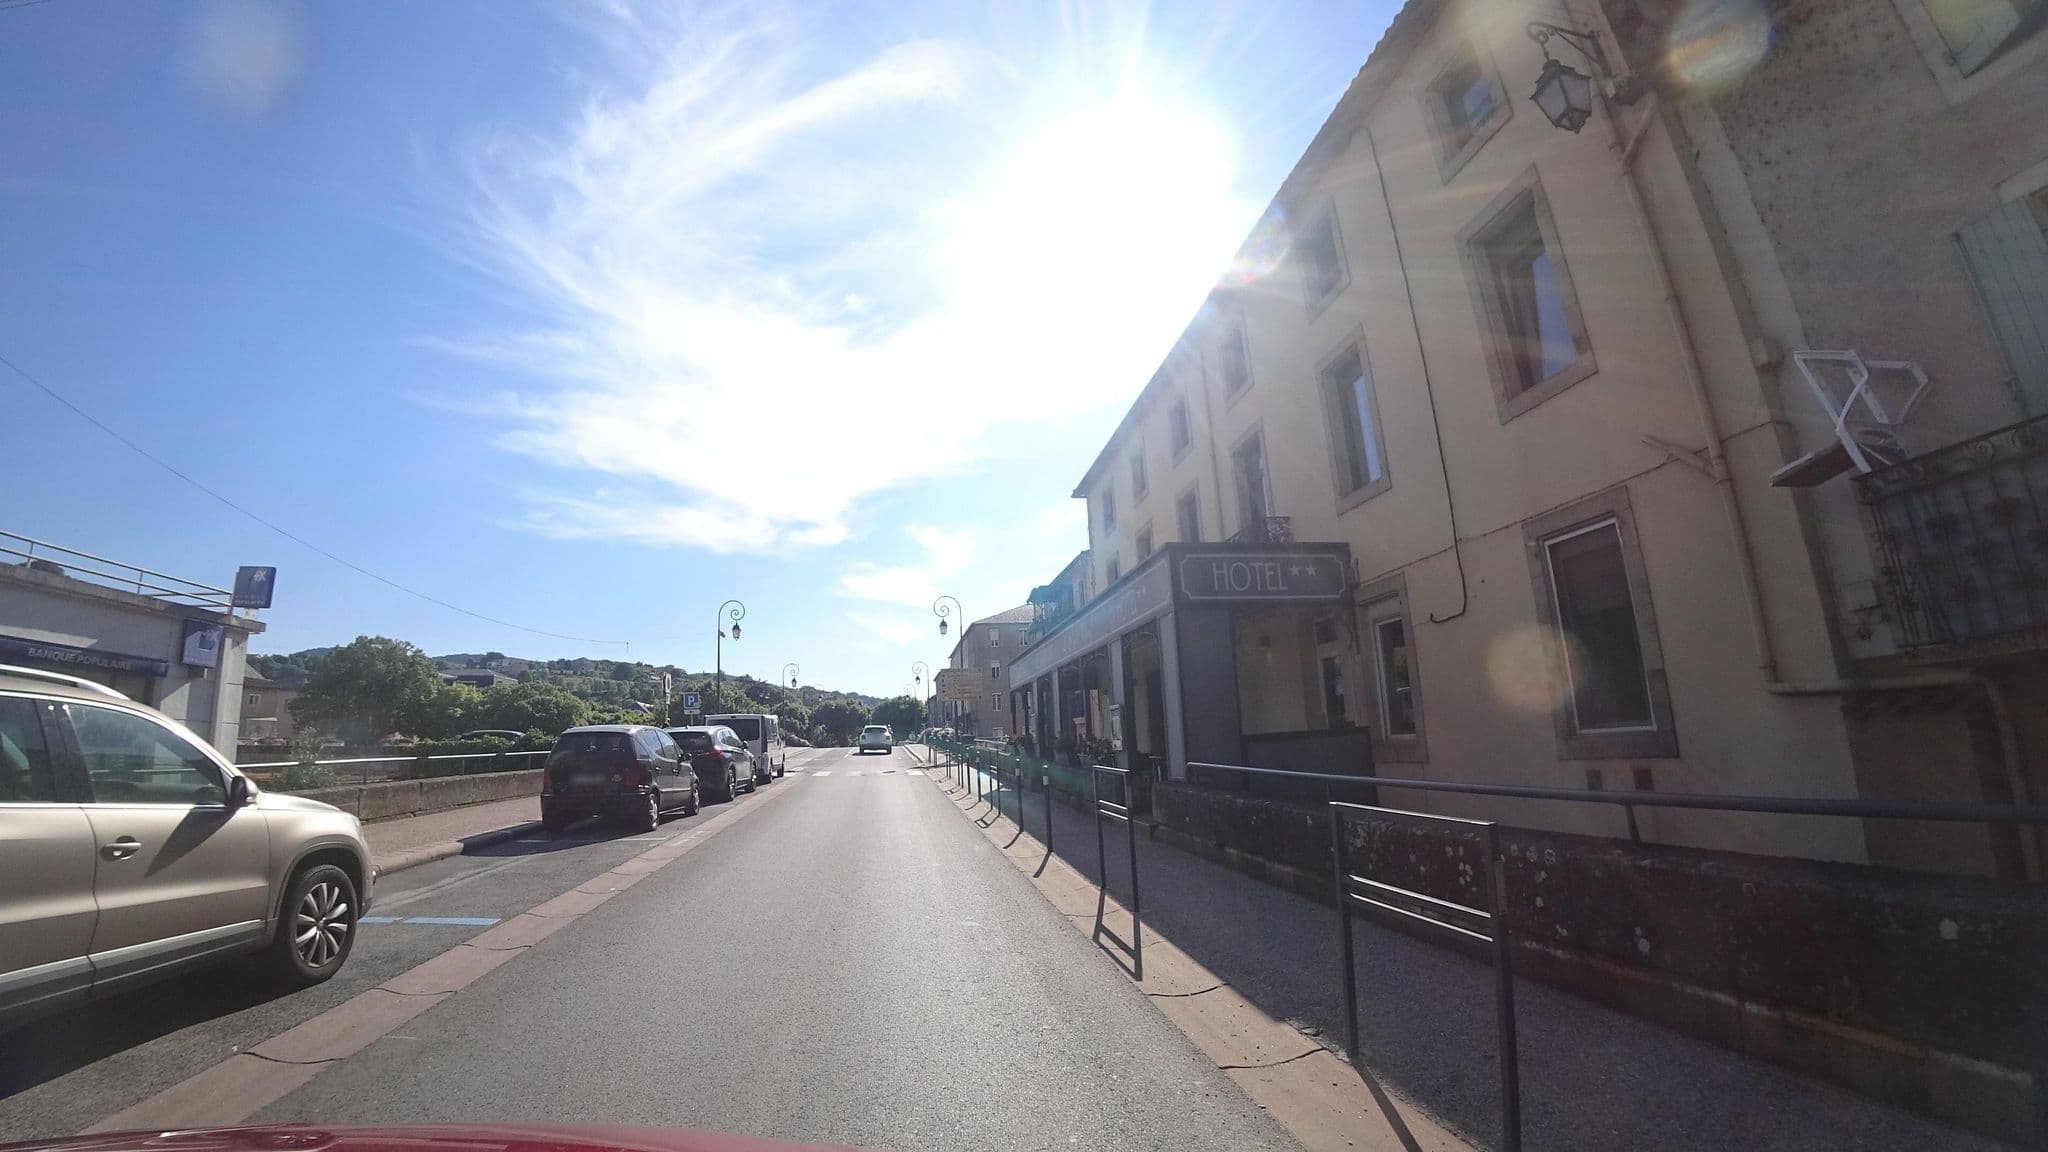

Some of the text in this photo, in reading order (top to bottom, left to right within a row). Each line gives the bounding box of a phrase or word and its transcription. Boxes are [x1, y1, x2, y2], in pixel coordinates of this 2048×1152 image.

[1211, 561, 1289, 592] HOTEL
[28, 647, 132, 669] BANQUE POPULAIRE
[687, 695, 695, 706] P
